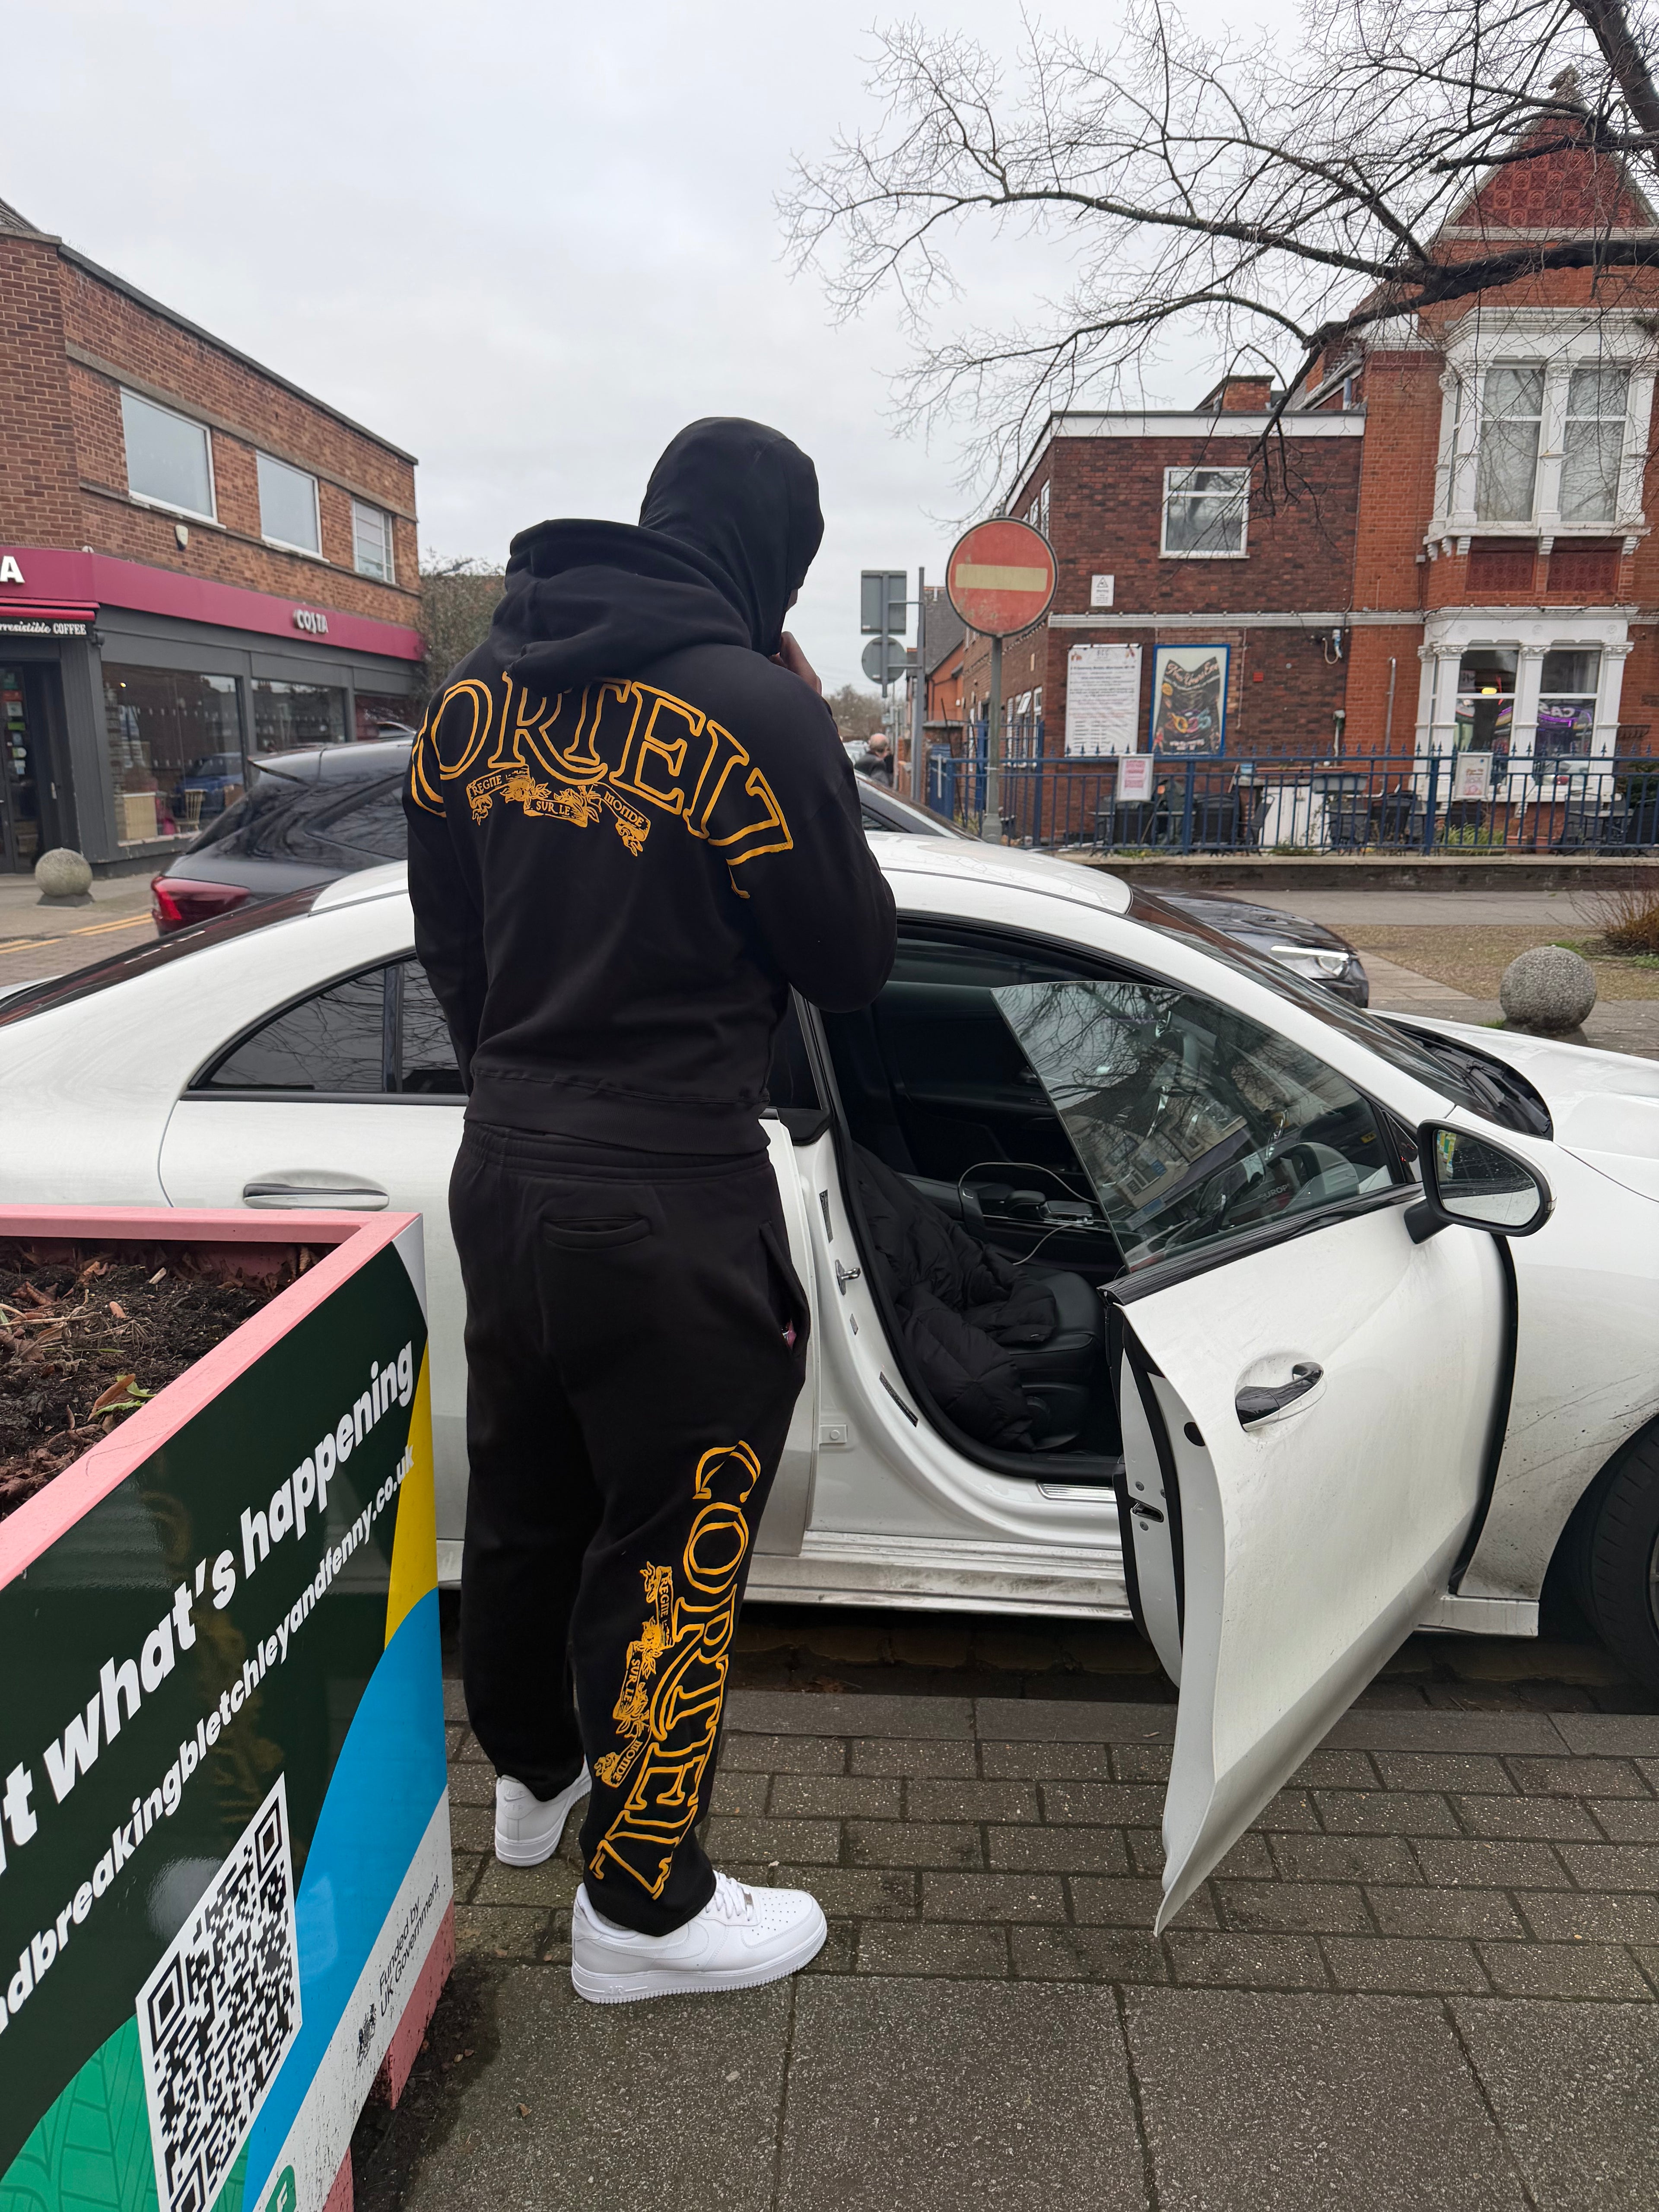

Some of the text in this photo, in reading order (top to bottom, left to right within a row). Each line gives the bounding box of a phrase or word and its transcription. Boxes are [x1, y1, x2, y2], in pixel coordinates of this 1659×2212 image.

[53, 622, 86, 635] COFFEE
[536, 800, 558, 814] SUR
[559, 804, 571, 816] LE
[0, 1341, 413, 1875] t what's happening
[628, 1659, 640, 1683] SUR
[623, 1688, 634, 1702] LE
[380, 1896, 420, 1996] Funded by
[381, 1874, 439, 2017] UK Government
